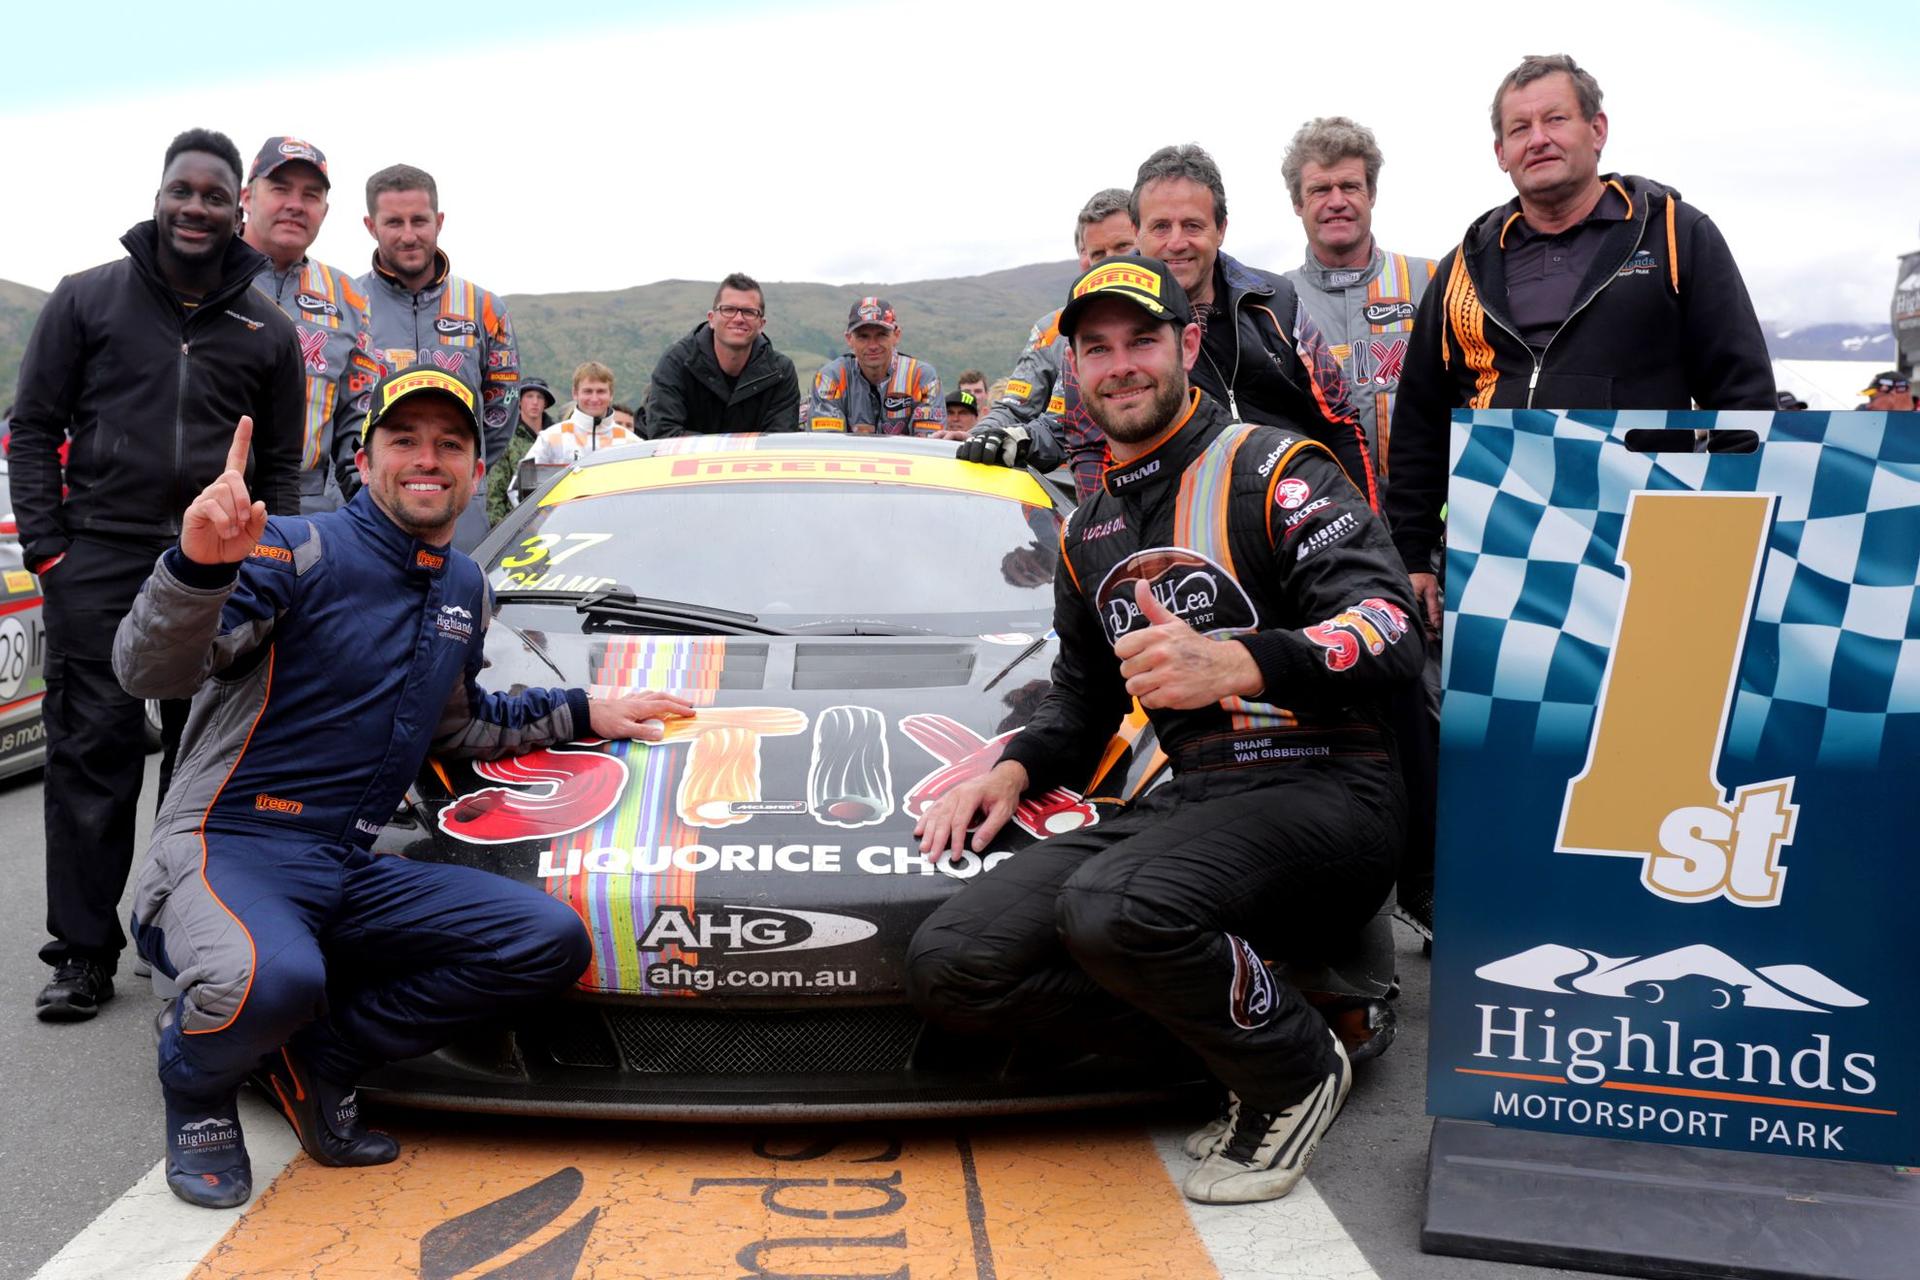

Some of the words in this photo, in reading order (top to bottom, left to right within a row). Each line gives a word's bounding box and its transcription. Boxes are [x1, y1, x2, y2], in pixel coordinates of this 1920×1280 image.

[671, 456, 914, 477] PIRELLI
[1258, 437, 1294, 477] Sabelt
[1113, 460, 1160, 487] TEKNO
[1308, 512, 1354, 545] LIBERTY
[501, 533, 613, 568] 37
[1195, 613, 1215, 625] 1927
[0, 632, 24, 682] 28
[1233, 738, 1272, 751] SHANE
[1235, 751, 1258, 762] VAN
[1261, 747, 1330, 760] GISBERGEN
[256, 794, 303, 815] freem
[537, 845, 841, 877] LIQUORICE
[641, 911, 787, 949] AHG
[650, 964, 857, 989] ahg.com.au
[1473, 1004, 1878, 1095] Highlands
[1493, 1091, 1728, 1138] MOTORSPORT
[1750, 1117, 1844, 1151] PARK
[178, 1128, 238, 1147] Highlands
